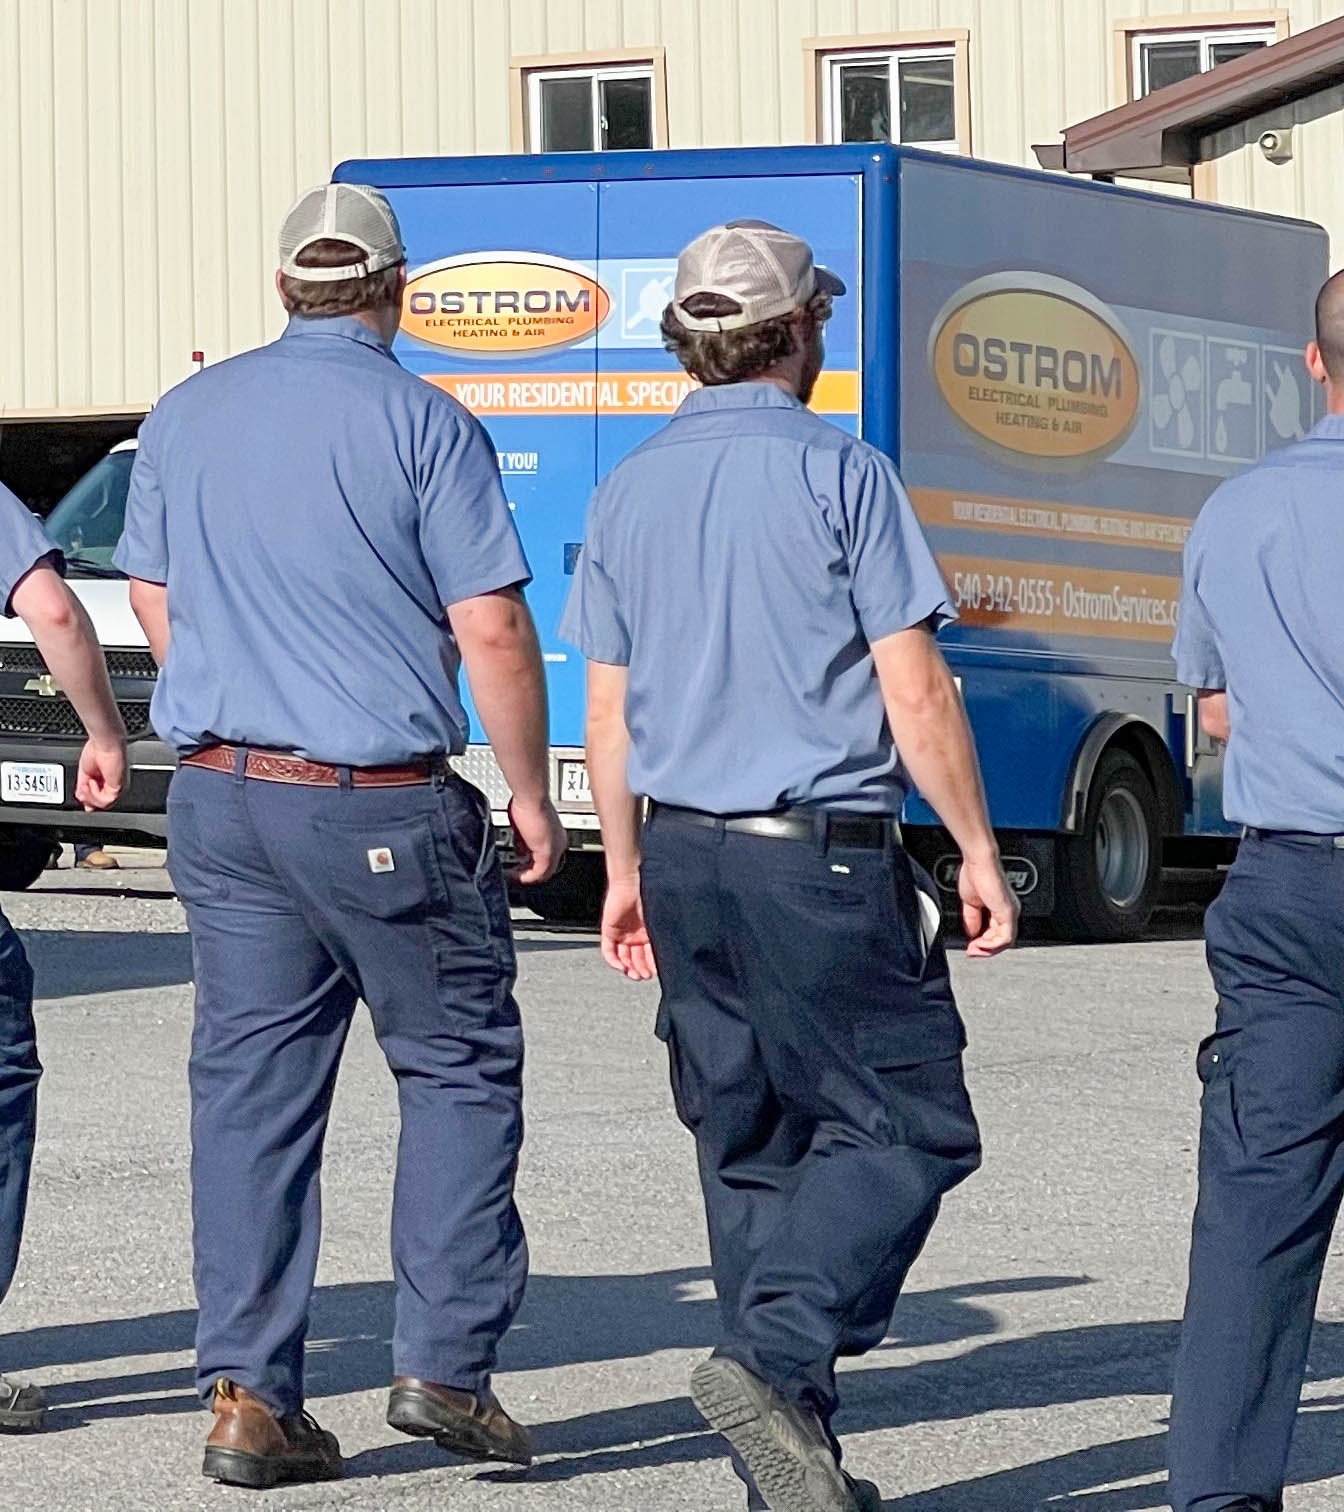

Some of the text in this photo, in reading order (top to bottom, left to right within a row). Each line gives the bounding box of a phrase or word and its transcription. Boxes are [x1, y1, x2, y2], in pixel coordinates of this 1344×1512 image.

[410, 289, 590, 315] OSTROM
[425, 316, 574, 327] ELECTRICAL PLUMBING
[453, 329, 508, 338] HEATING
[524, 328, 545, 337] AIR
[952, 333, 1122, 400] OSTROM
[455, 383, 505, 408] YOUR
[626, 381, 697, 407] SPECIA
[968, 386, 1040, 409] ELECTRICAL
[996, 411, 1049, 430] HEATING
[1063, 420, 1083, 434] AIR
[506, 452, 538, 470] YOU!
[954, 572, 1180, 626] 540-342-0555 OstromServices.c
